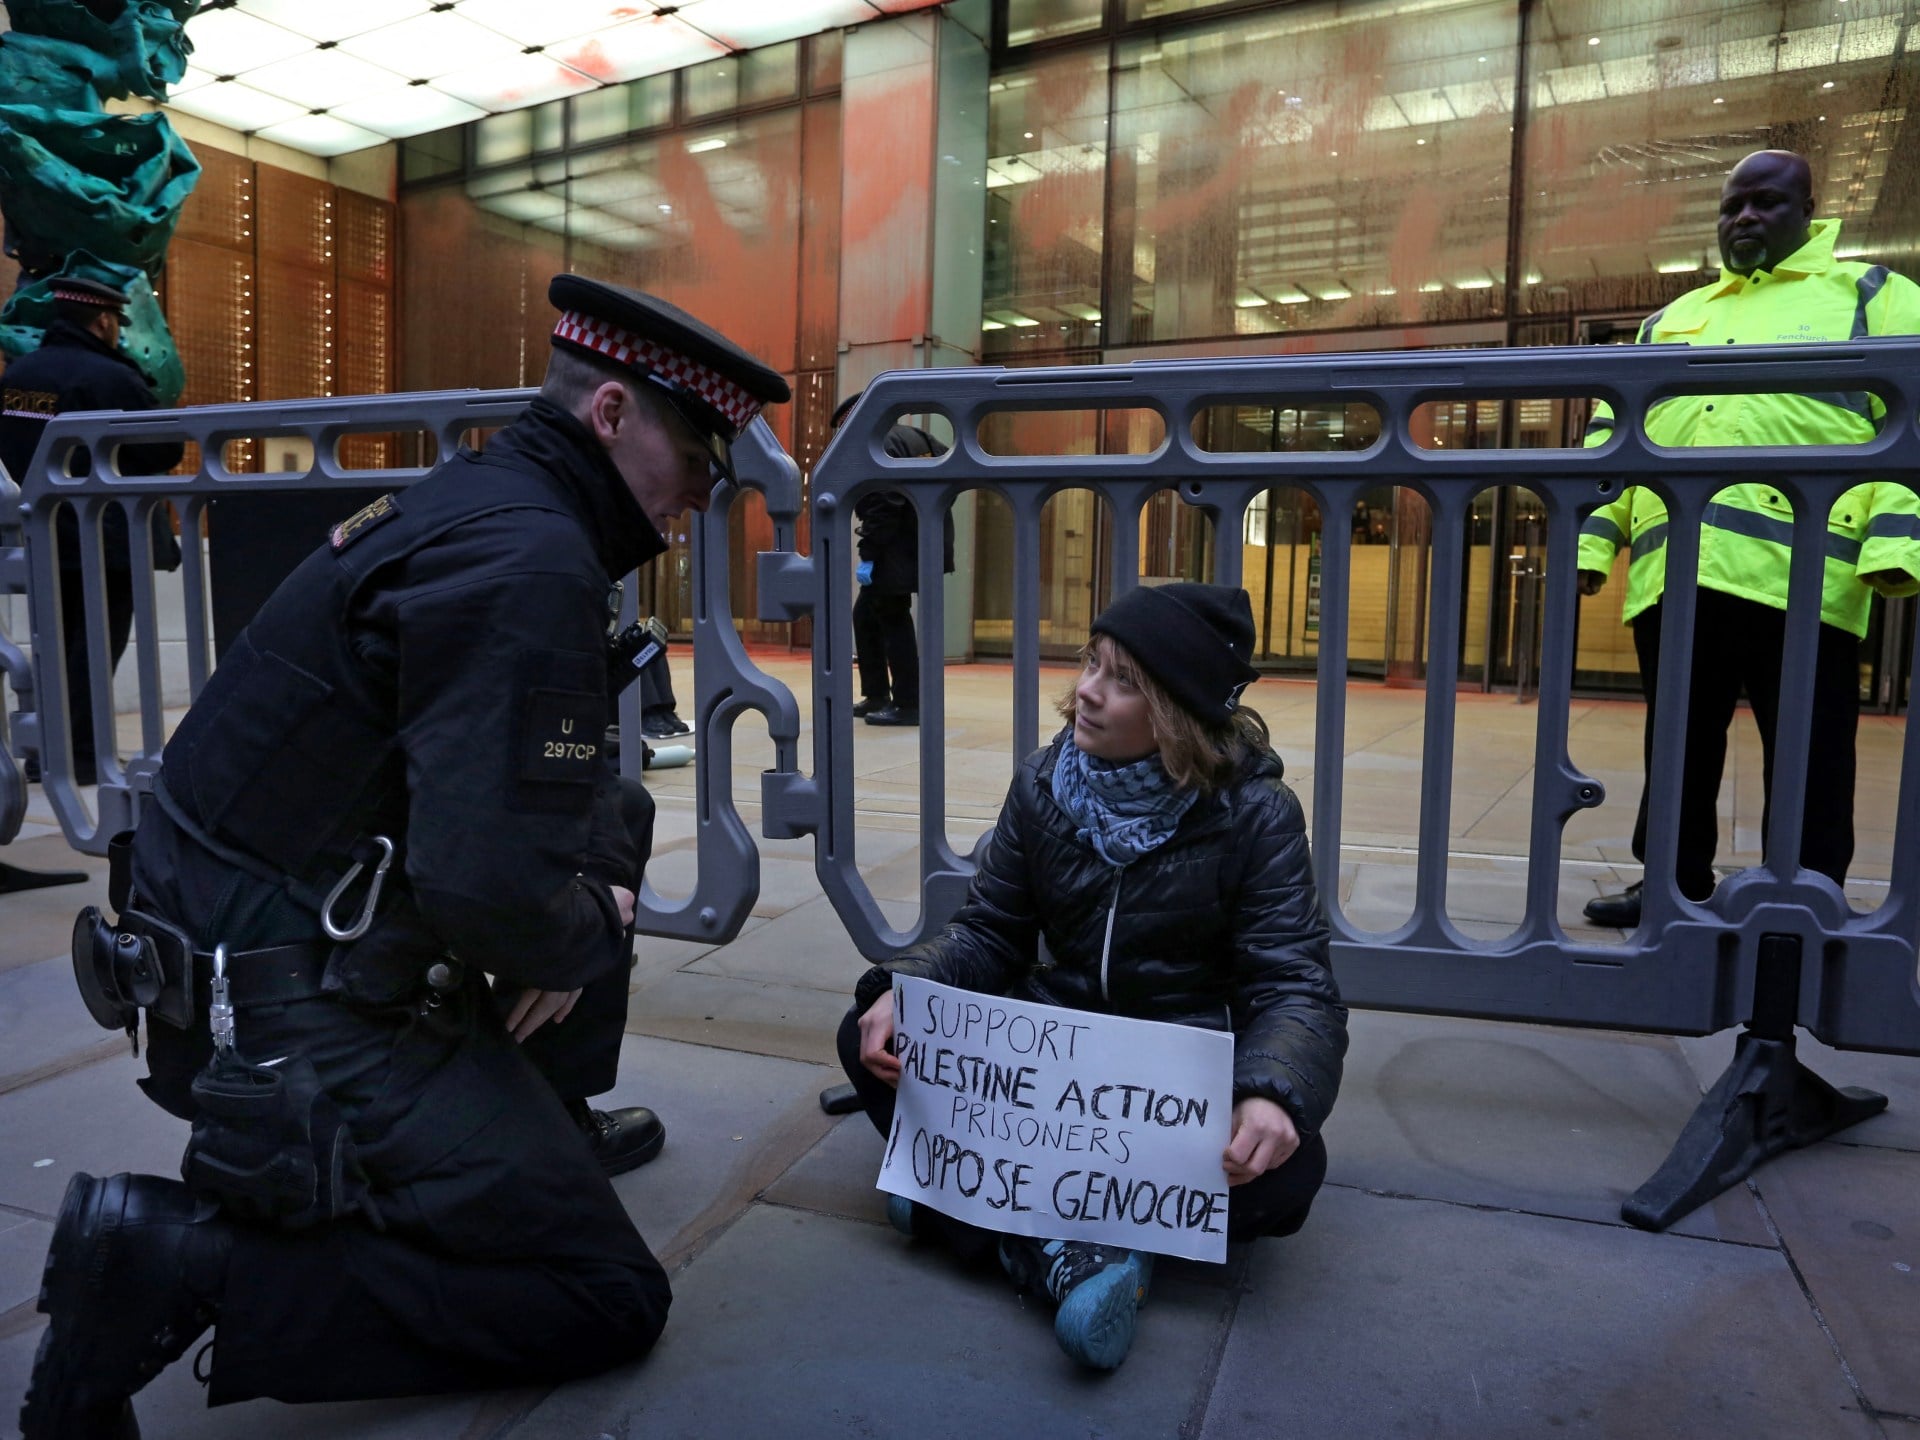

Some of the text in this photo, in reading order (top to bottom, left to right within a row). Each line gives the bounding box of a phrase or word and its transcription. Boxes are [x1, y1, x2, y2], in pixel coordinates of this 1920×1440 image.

[1776, 333, 1828, 342] Fenchurch
[4, 395, 57, 413] POLICE
[561, 718, 574, 735] U
[543, 741, 597, 761] 297CP
[922, 994, 1090, 1060] SUPPORT
[895, 1032, 1208, 1128] PALESTINE ACTION
[951, 1096, 1133, 1164] PRISONERS
[912, 1127, 1034, 1212] OPPOSE
[1052, 1170, 1229, 1234] GENOCIDE
